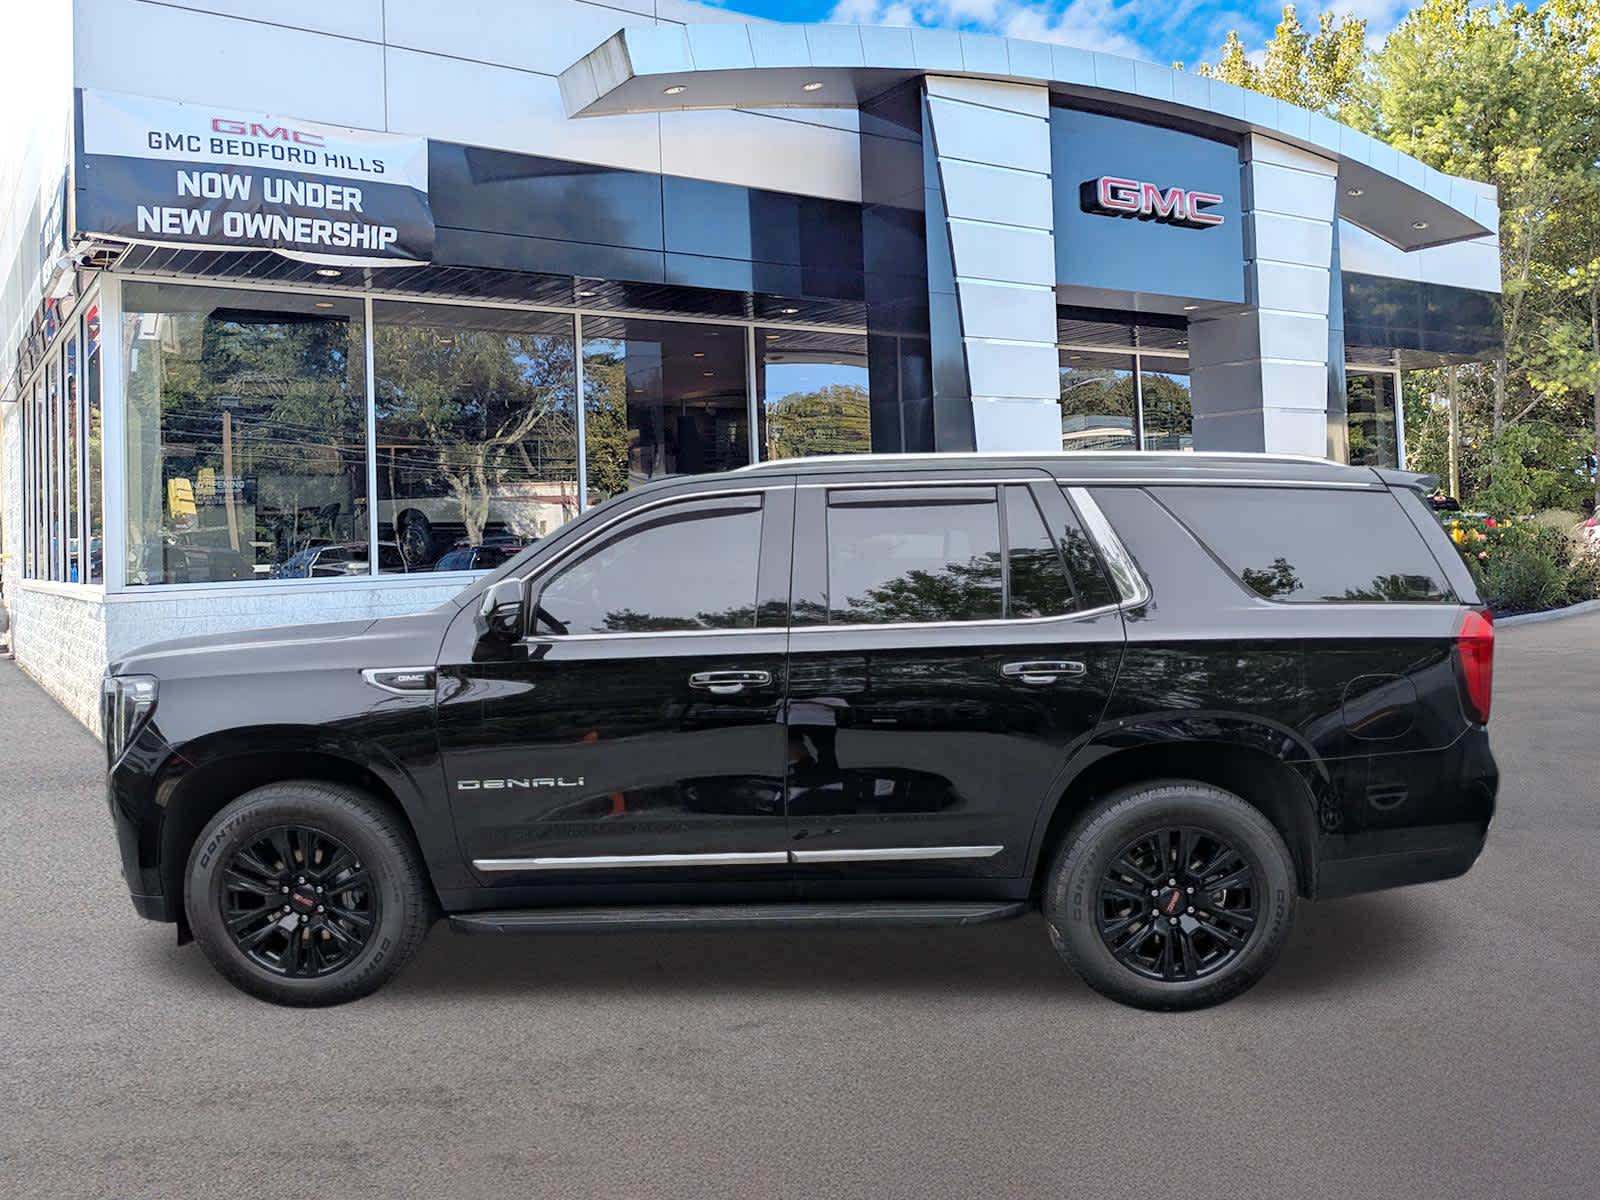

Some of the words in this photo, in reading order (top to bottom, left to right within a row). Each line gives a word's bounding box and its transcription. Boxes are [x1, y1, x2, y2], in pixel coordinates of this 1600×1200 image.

[147, 131, 201, 153] GMC
[209, 137, 317, 165] BEDFORD
[324, 153, 386, 175] HILLS
[210, 118, 326, 148] GMC
[176, 170, 252, 201] NOW
[262, 176, 364, 213] UNDER
[1097, 175, 1225, 226] GMC
[136, 205, 212, 237] NEW
[222, 211, 399, 251] OWNERSHIP
[398, 674, 425, 682] GMC
[457, 776, 586, 791] DENALI
